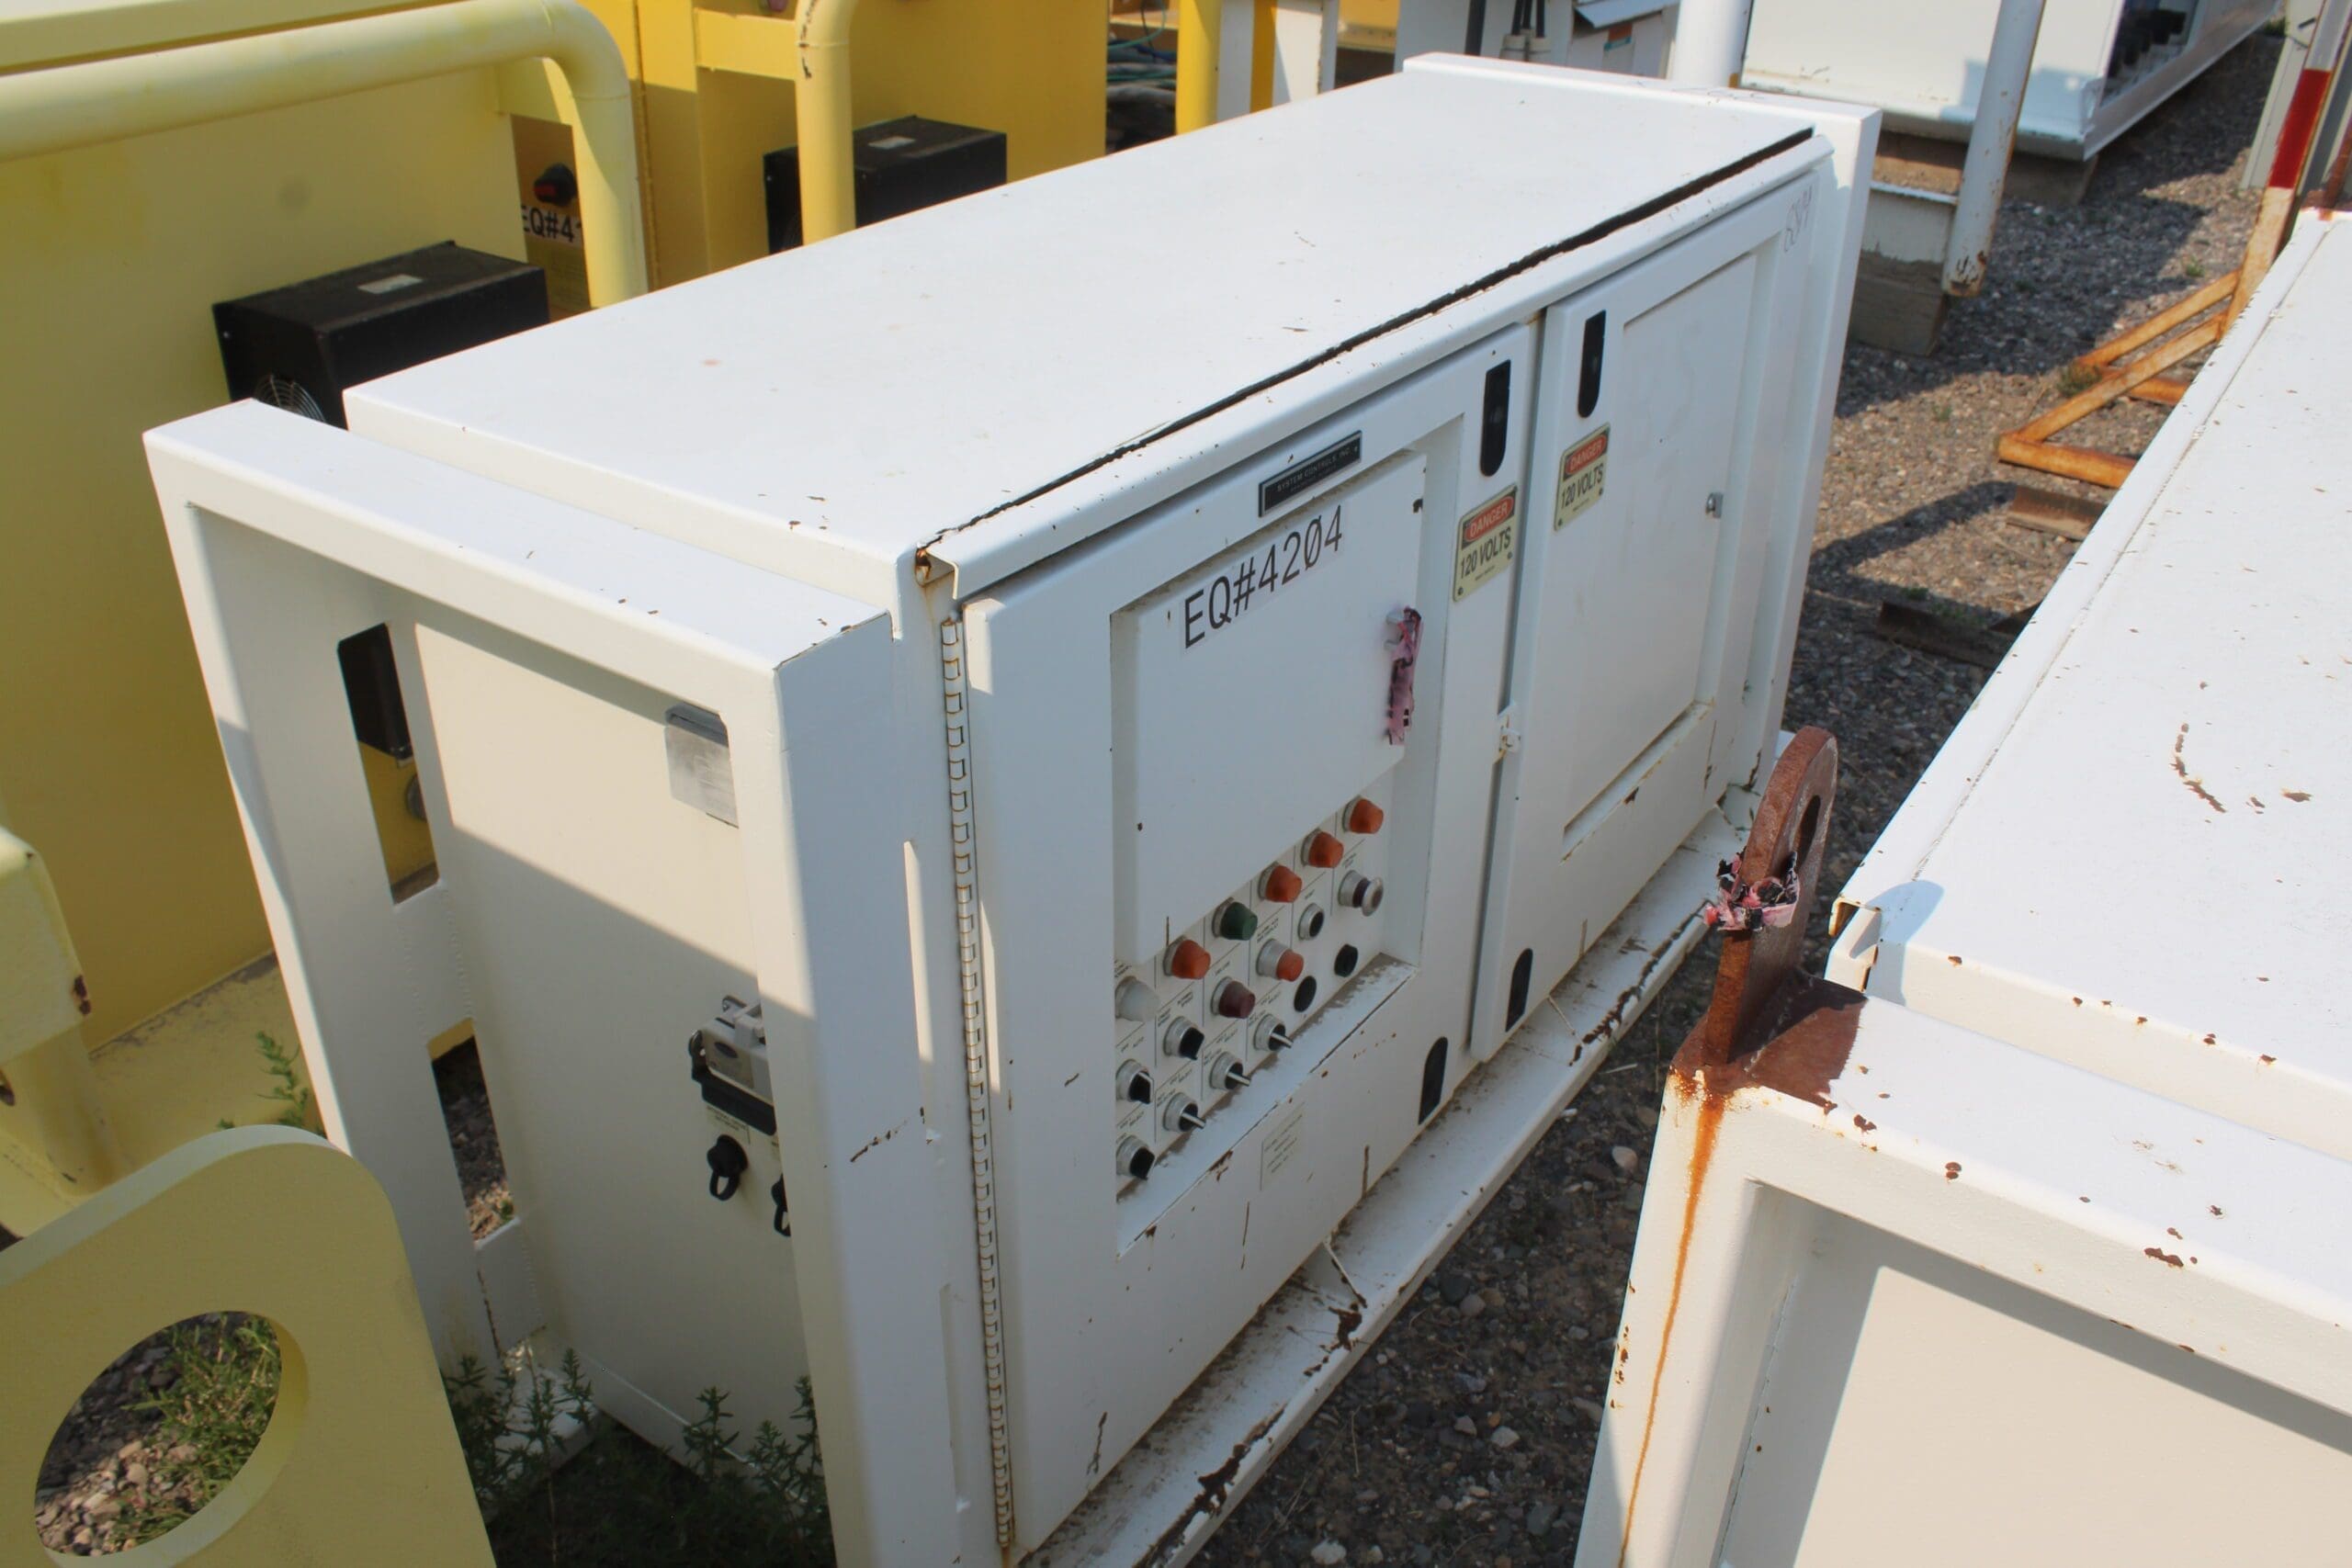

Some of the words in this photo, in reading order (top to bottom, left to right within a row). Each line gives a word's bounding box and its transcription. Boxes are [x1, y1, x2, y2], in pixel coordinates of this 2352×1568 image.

[522, 205, 582, 243] Q#4
[1570, 440, 1604, 470] DANGER
[1562, 484, 1576, 509] 120
[1577, 462, 1604, 500] VOLTS
[1469, 502, 1509, 538] DANGER
[1460, 552, 1477, 579] 120
[1479, 526, 1511, 567] VOLTS
[1184, 504, 1342, 649] EQ#4204
